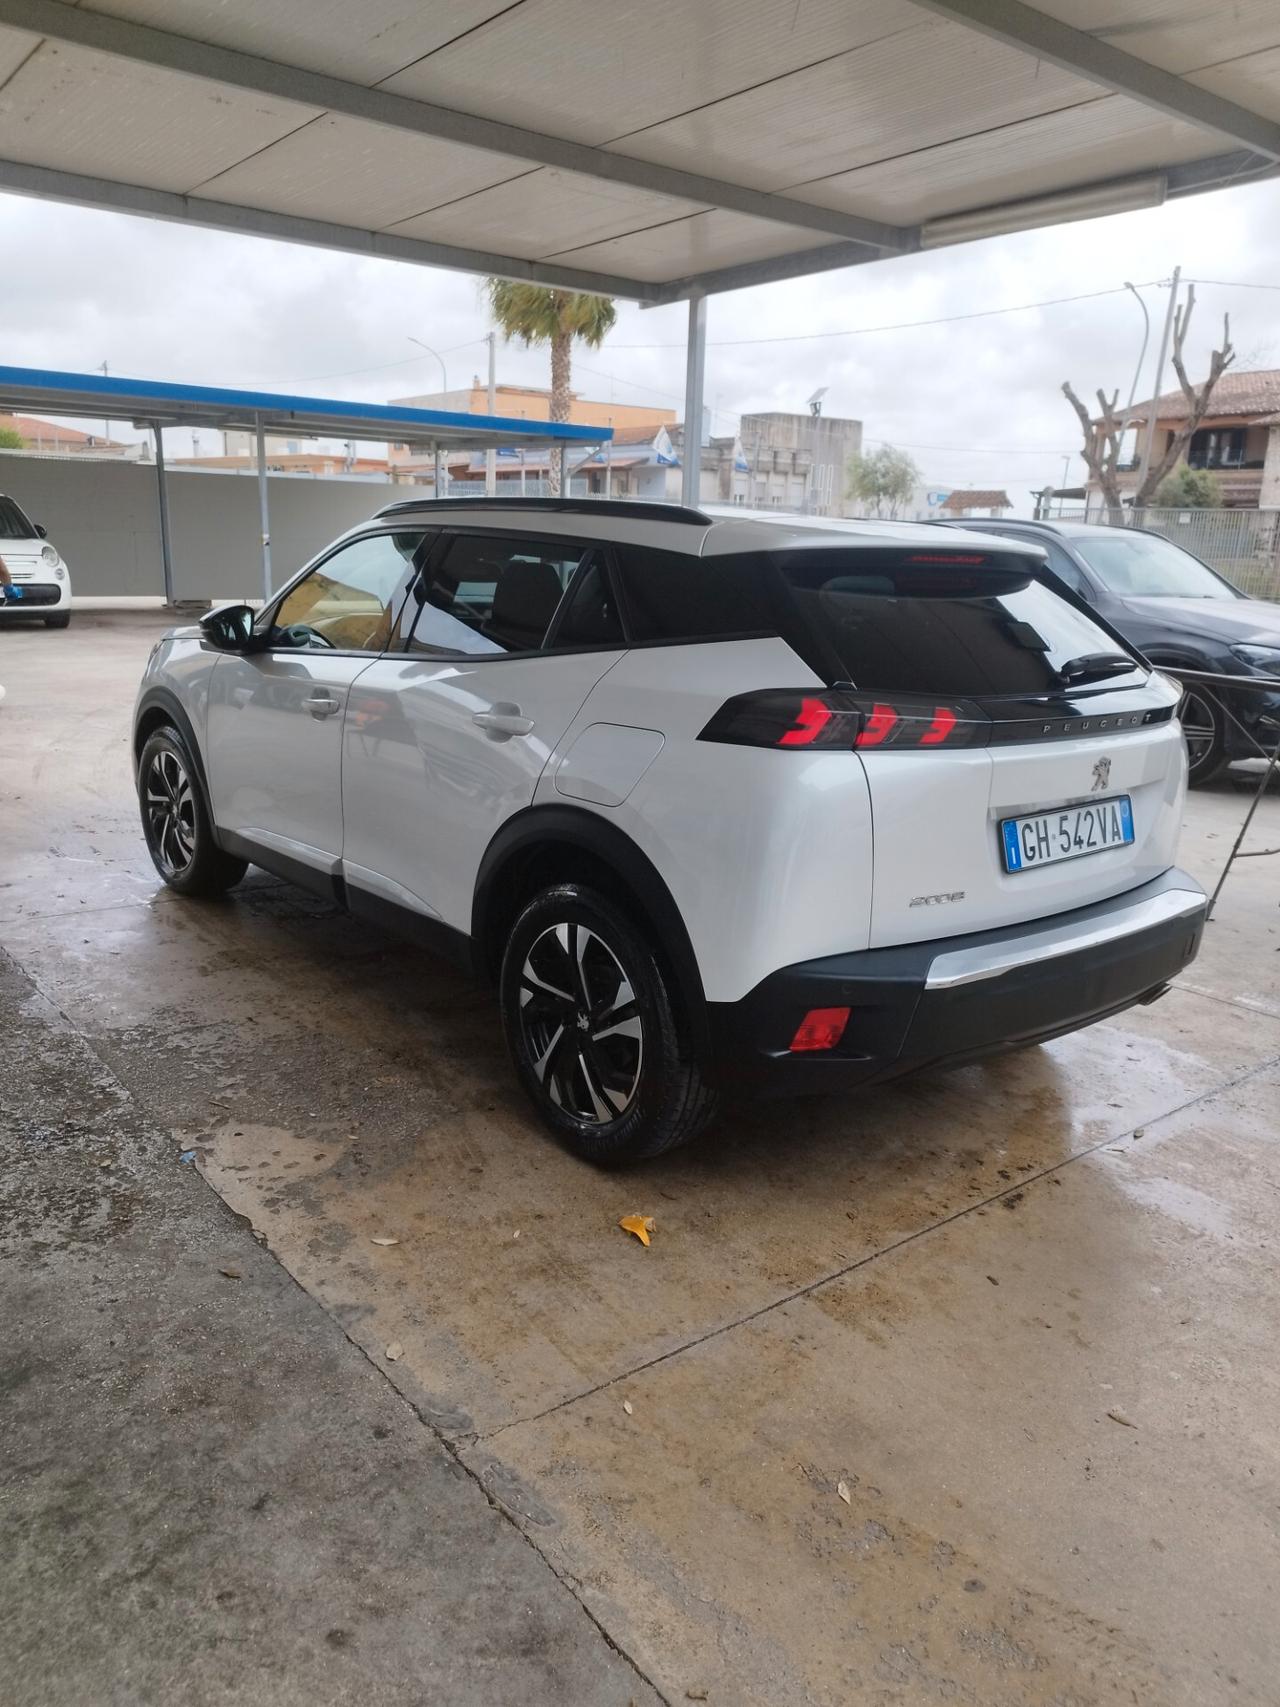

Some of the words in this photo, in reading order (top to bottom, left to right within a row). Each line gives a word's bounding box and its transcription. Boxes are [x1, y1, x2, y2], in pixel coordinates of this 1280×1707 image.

[1043, 714, 1151, 733] PEUGEOT
[1021, 819, 1051, 861] GH
[1059, 805, 1122, 853] 542VA
